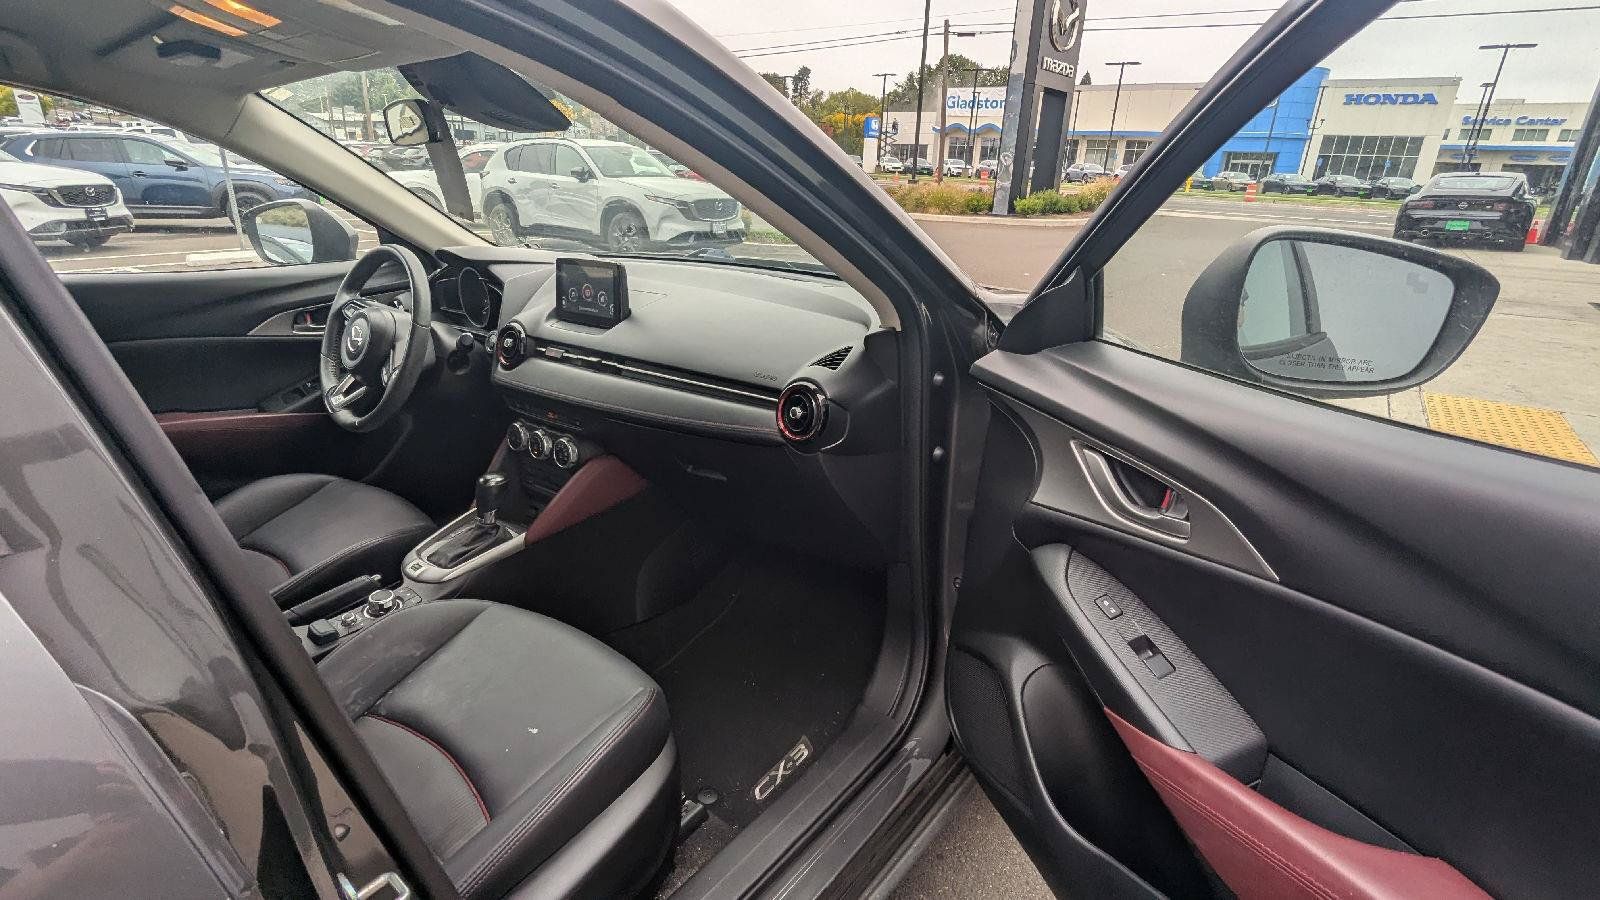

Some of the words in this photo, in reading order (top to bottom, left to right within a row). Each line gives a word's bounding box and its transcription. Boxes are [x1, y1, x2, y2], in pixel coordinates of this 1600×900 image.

[1041, 56, 1075, 78] mazda
[1343, 93, 1438, 105] HONDA
[1462, 116, 1512, 126] Service
[1515, 115, 1567, 126] Center
[1347, 365, 1375, 374] APPEAR
[755, 743, 809, 800] CX-3
